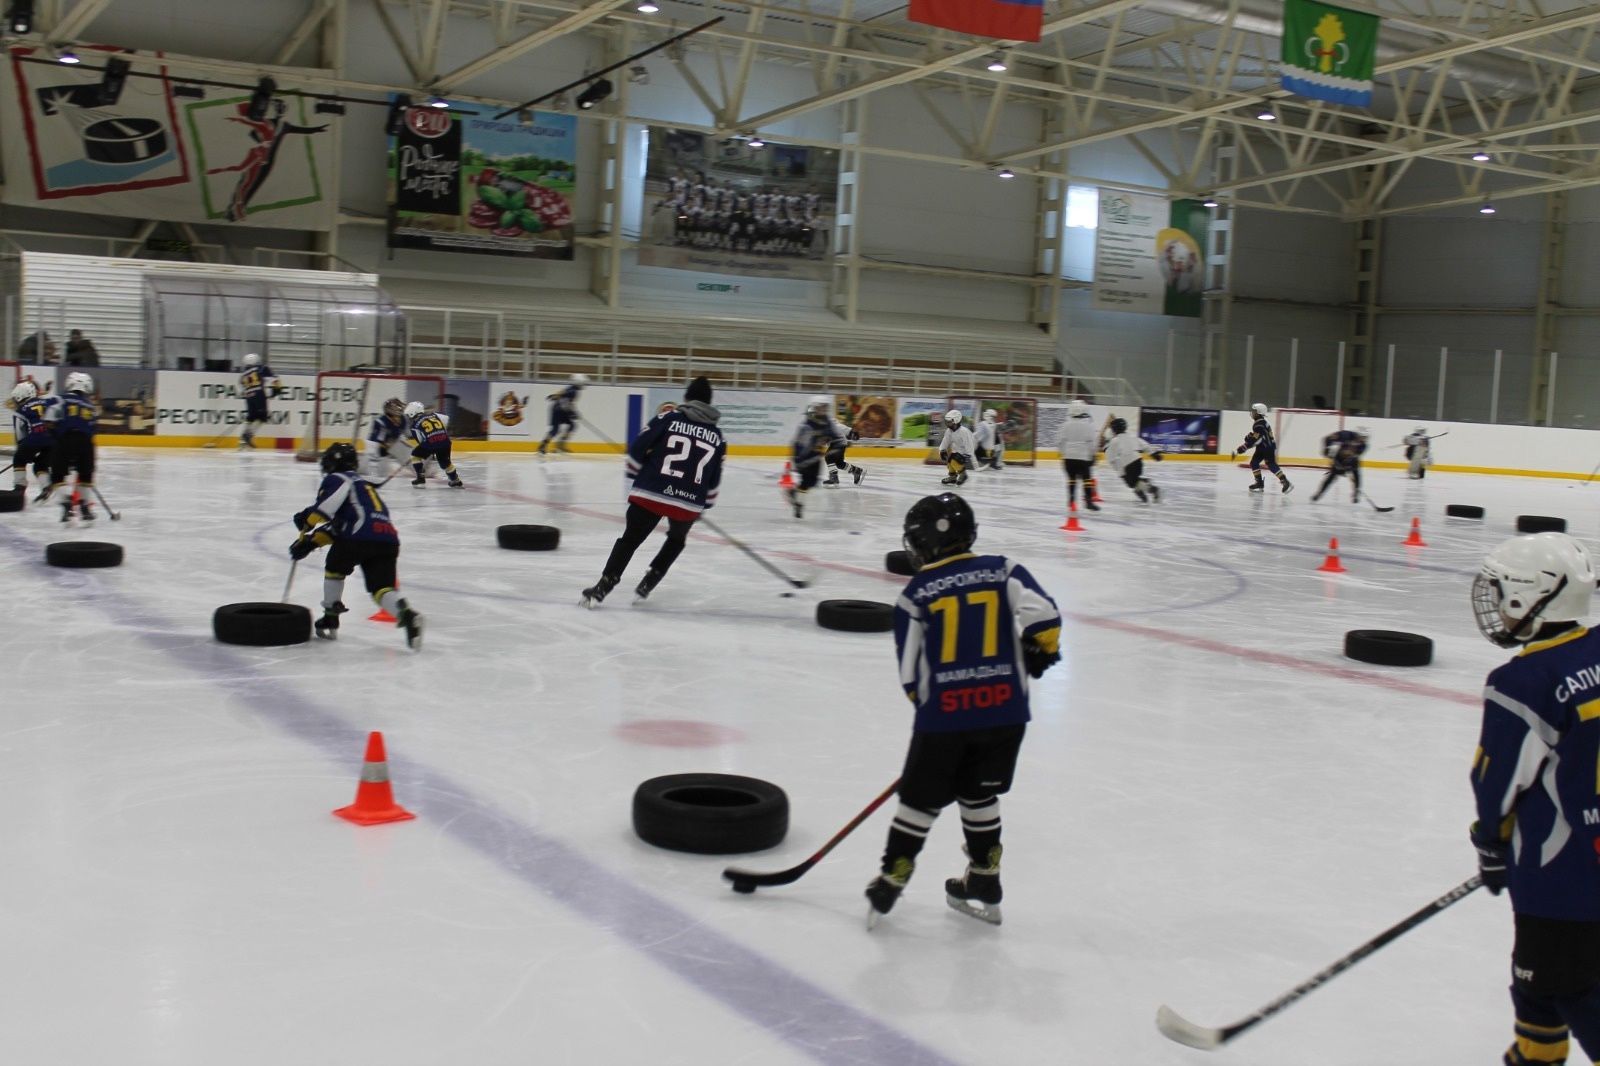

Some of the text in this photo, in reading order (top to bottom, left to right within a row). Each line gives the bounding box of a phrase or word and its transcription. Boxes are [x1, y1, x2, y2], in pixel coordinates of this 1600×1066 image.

[200, 384, 365, 402] ПРАЕЛЬСТВО
[661, 434, 716, 485] 27
[928, 590, 999, 664] 17
[935, 664, 1013, 684] МАМАДЫШ
[1555, 664, 1600, 703] САЛИ
[941, 683, 1012, 713] STOP
